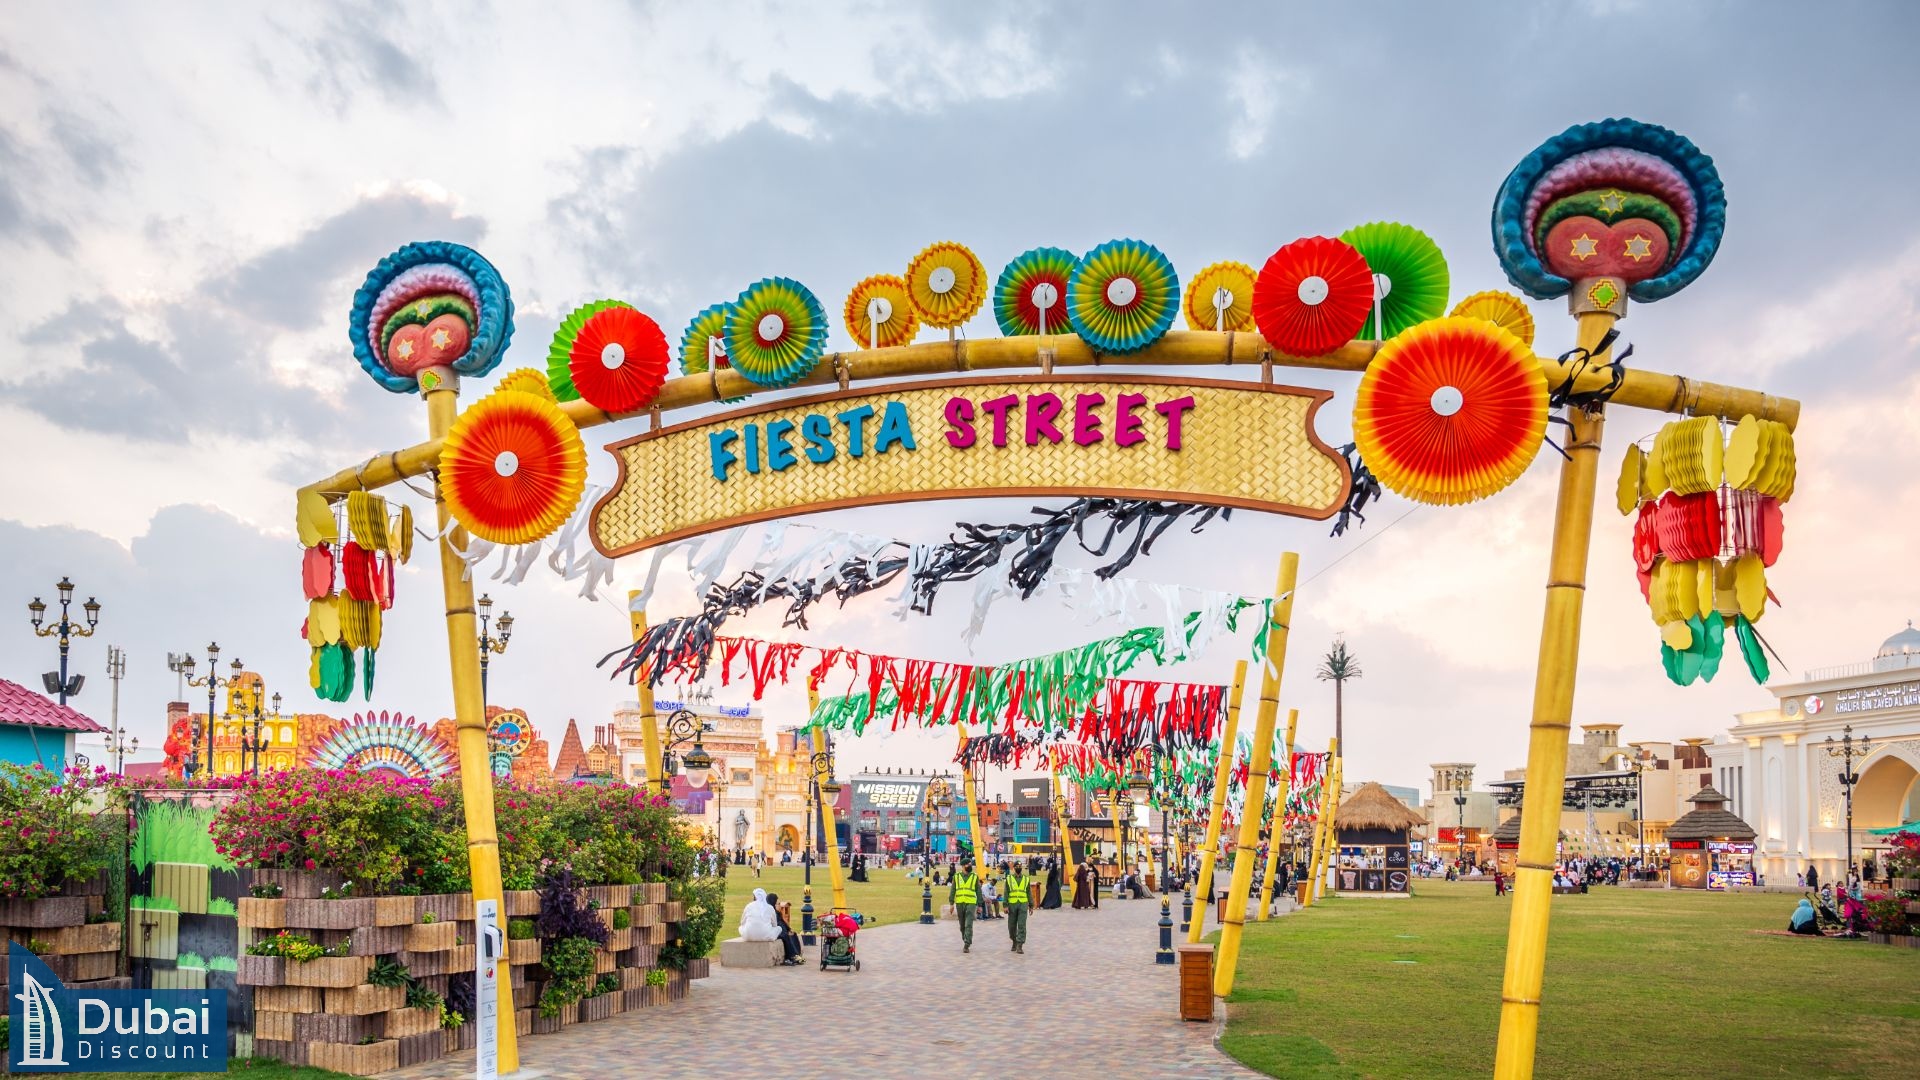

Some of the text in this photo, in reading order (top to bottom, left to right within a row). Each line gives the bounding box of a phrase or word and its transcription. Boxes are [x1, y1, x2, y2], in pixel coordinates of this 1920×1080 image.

[709, 392, 1196, 481] FIESTA STREET
[1835, 701, 1860, 714] KHALIFA
[1862, 699, 1872, 711] BIN
[1873, 697, 1893, 709] ZAYED
[1894, 695, 1903, 707] AL
[857, 783, 921, 795] MISSION
[869, 793, 918, 804] SPEED
